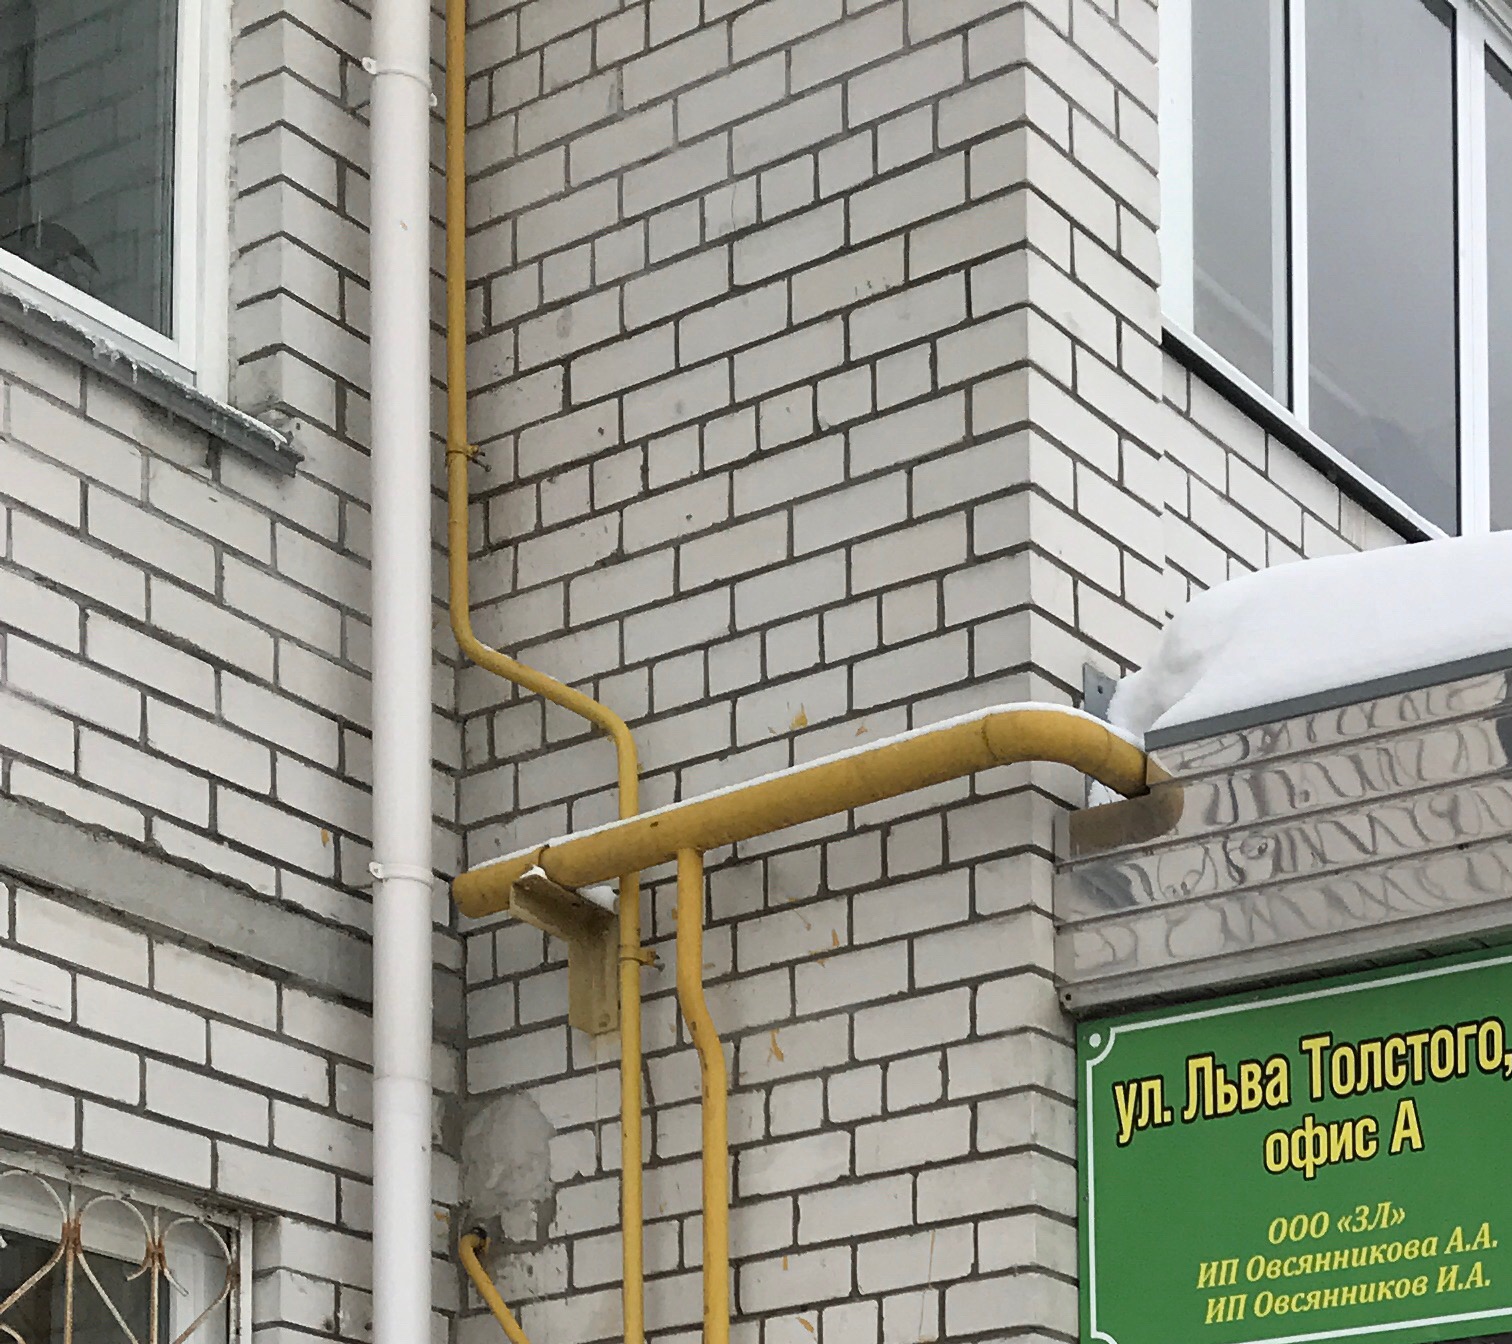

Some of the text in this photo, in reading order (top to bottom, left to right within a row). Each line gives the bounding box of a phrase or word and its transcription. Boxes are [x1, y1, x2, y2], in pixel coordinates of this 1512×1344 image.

[1112, 1076, 1174, 1145] ул.
[1183, 1055, 1291, 1122] Льва
[1263, 1099, 1424, 1180] офис А
[1196, 1223, 1499, 1291] ИП Овсянникова А.А.
[1267, 1211, 1330, 1245] ООО
[1204, 1262, 1491, 1326] ИП Овсянников И.А.
